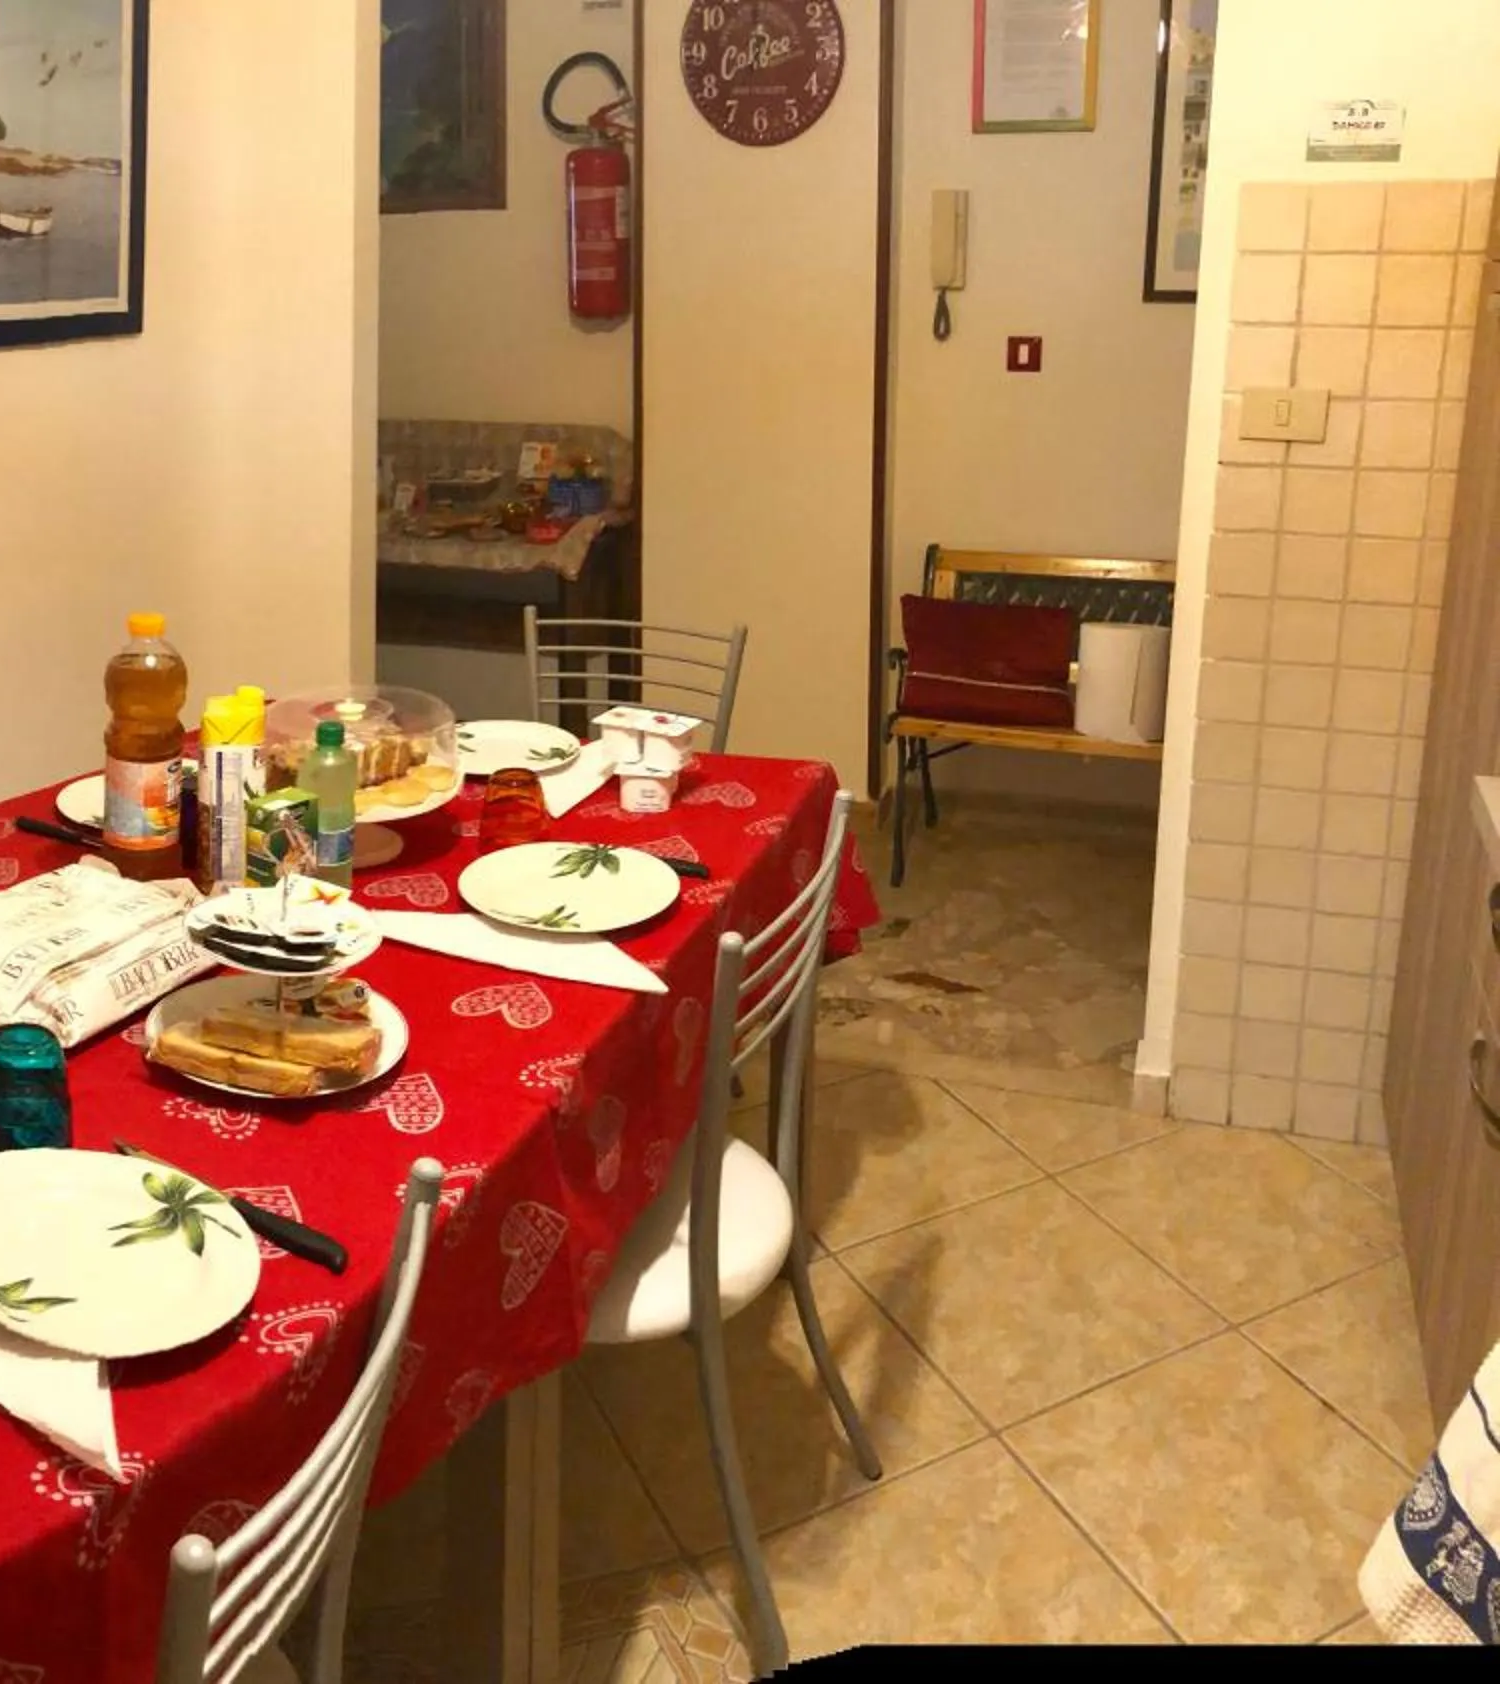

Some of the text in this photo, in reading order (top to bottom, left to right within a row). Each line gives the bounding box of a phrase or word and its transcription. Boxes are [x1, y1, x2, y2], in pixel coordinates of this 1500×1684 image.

[703, 5, 725, 31] 10
[805, 3, 822, 28] 2
[703, 74, 719, 99] 8
[804, 71, 820, 97] 4
[725, 99, 739, 124] 7
[752, 107, 768, 132] 6
[784, 98, 799, 123] 5
